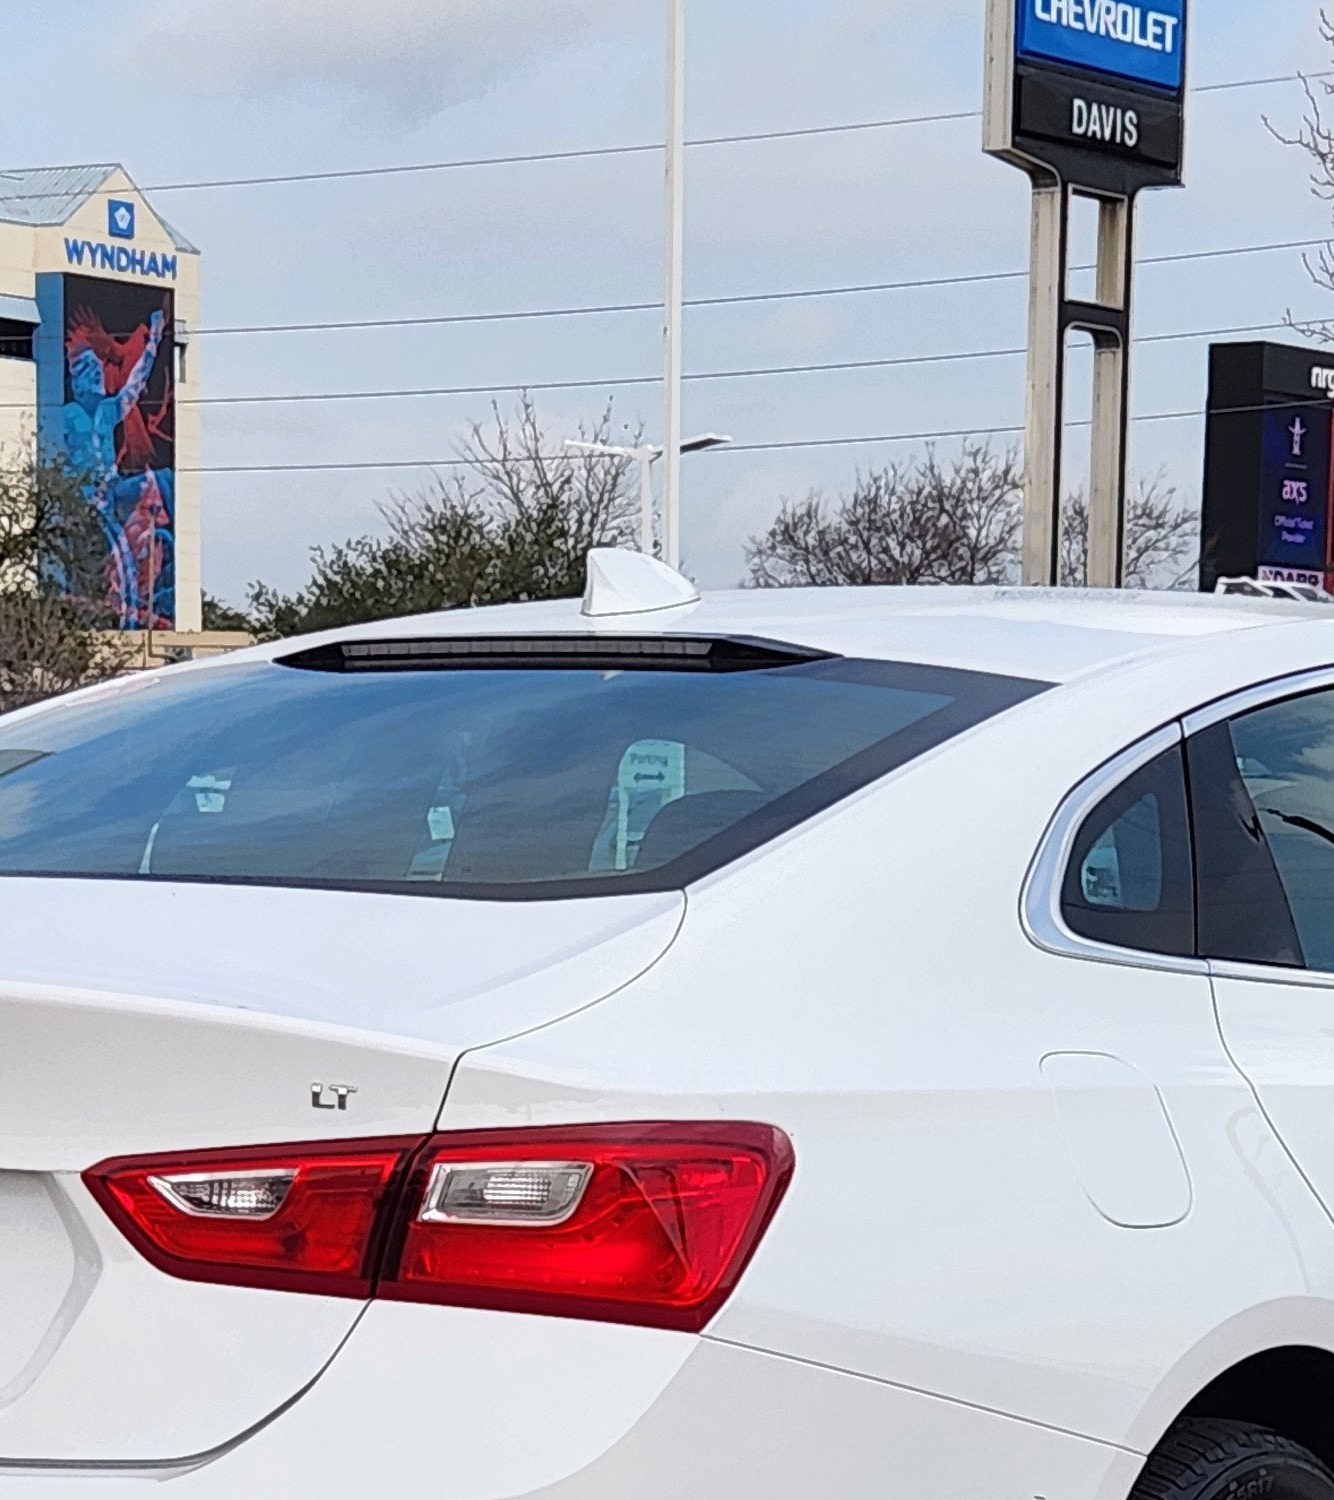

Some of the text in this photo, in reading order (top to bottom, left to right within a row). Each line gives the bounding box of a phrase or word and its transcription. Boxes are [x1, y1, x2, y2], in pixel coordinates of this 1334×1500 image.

[1033, 0, 1178, 53] CHEVROLET
[1071, 98, 1138, 148] DAVIS
[63, 237, 178, 280] WYNDHAM
[1281, 479, 1308, 504] axs
[310, 1082, 358, 1111] LT
